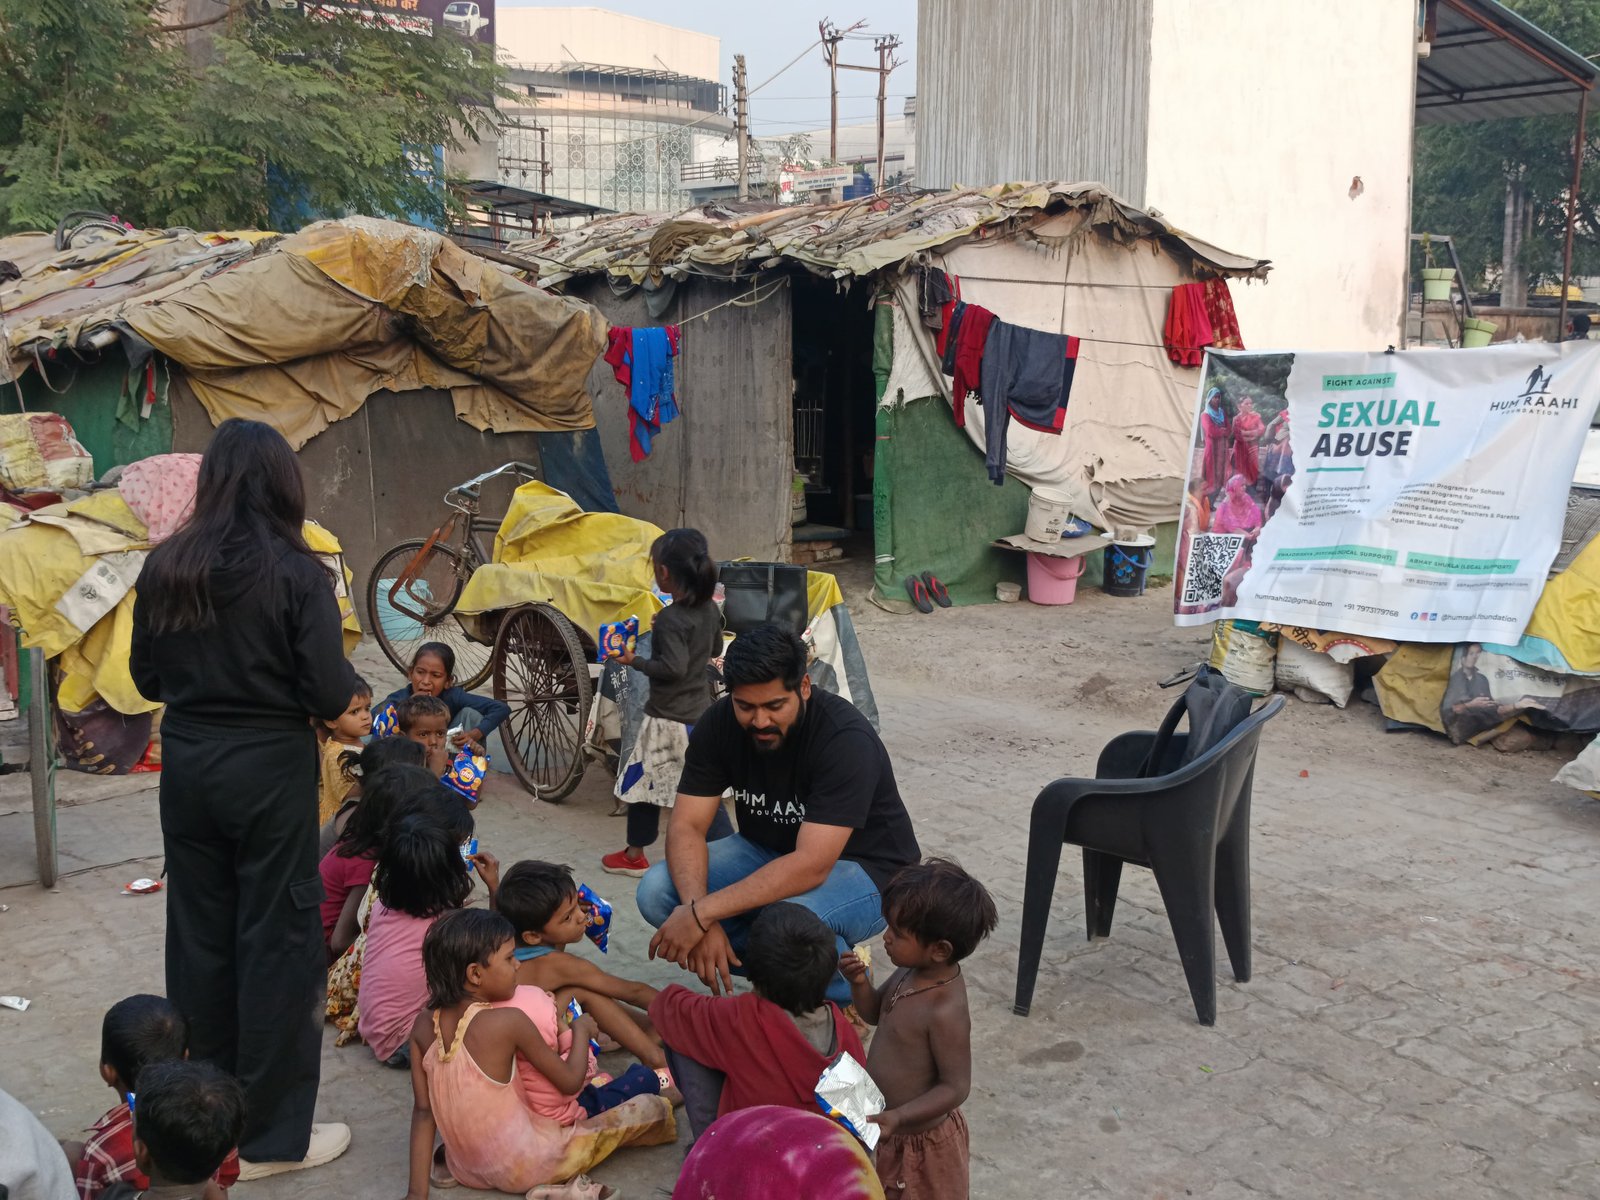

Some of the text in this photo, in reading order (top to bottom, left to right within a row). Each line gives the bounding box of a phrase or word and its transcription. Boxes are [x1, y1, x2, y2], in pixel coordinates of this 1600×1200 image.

[1327, 377, 1392, 387] FIGHT AGAINST
[1490, 396, 1579, 411] HUM RAAHI
[1317, 399, 1440, 428] SEXUAL
[1501, 408, 1559, 416] FOUNDATION
[1310, 431, 1413, 458] ABUSE
[1431, 490, 1463, 499] Programs
[1436, 483, 1468, 492] Programs
[1480, 488, 1505, 496] Schools
[1393, 501, 1419, 511] Training
[1421, 504, 1448, 514] Sessions
[1460, 510, 1489, 518] Teachers
[1448, 500, 1491, 510] Communities
[1390, 516, 1459, 530] Against Sexual Abuse
[1391, 509, 1427, 519] Prevention
[1434, 514, 1464, 524] Advocacy
[1255, 593, 1332, 607] humraahi22@gmail.com
[1356, 604, 1399, 617] 7973179768
